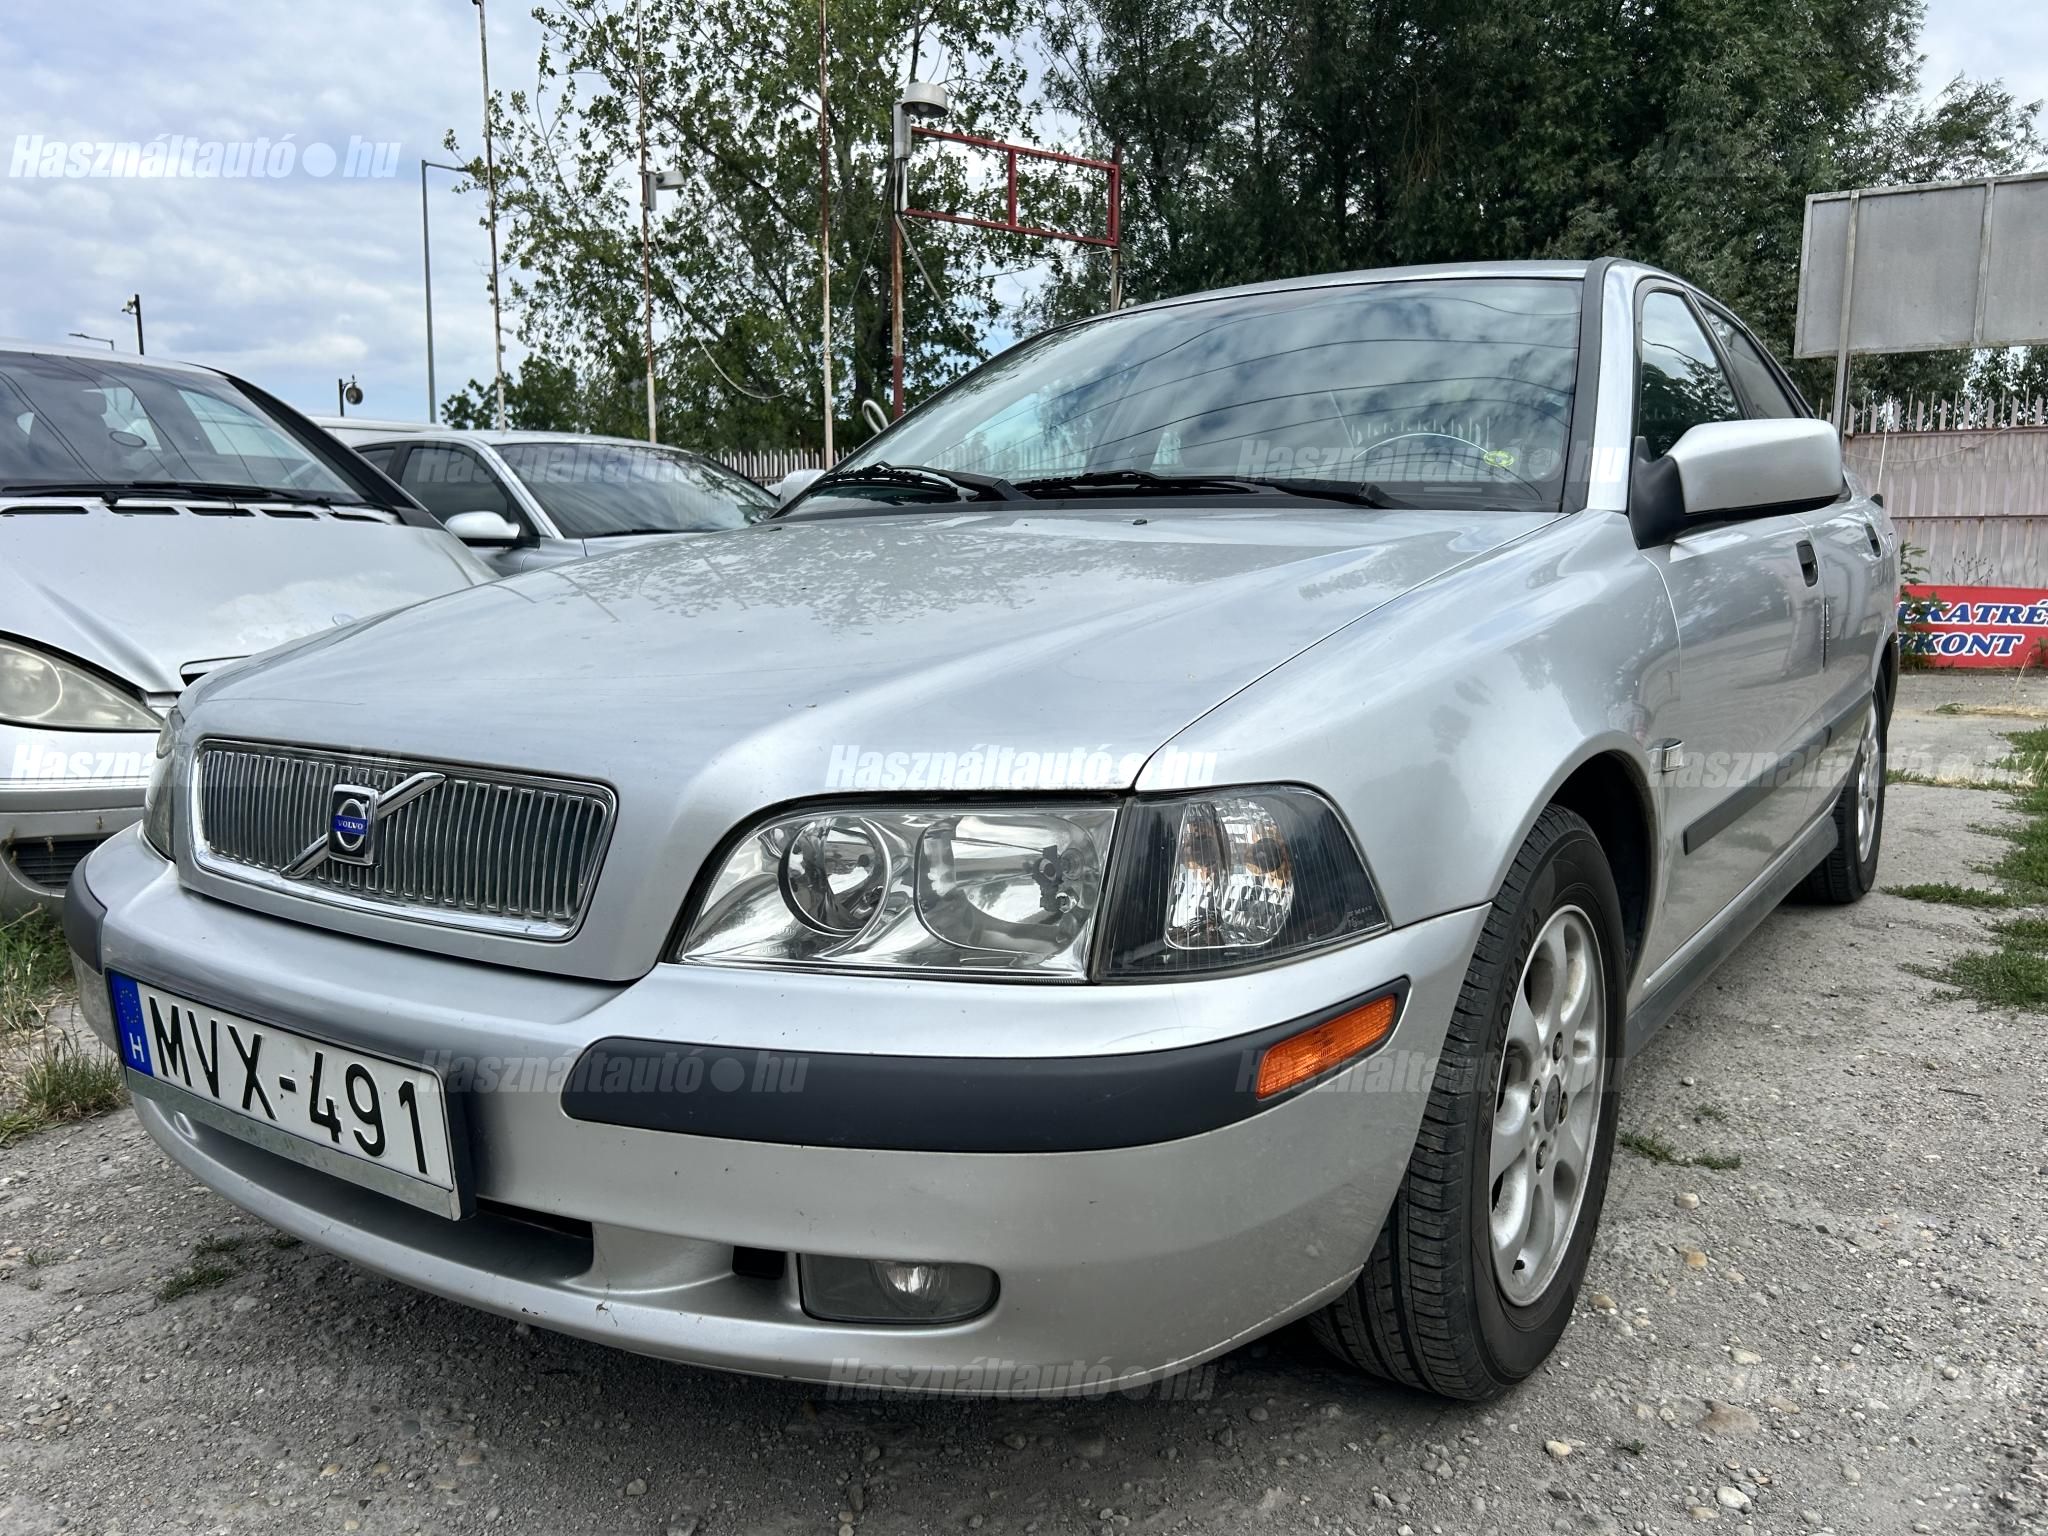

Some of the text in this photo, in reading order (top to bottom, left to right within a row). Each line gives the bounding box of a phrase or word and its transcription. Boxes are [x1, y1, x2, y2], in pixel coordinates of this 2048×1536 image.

[337, 820, 364, 831] VOLVO
[128, 1032, 145, 1063] H
[148, 996, 428, 1175] MVX-491
